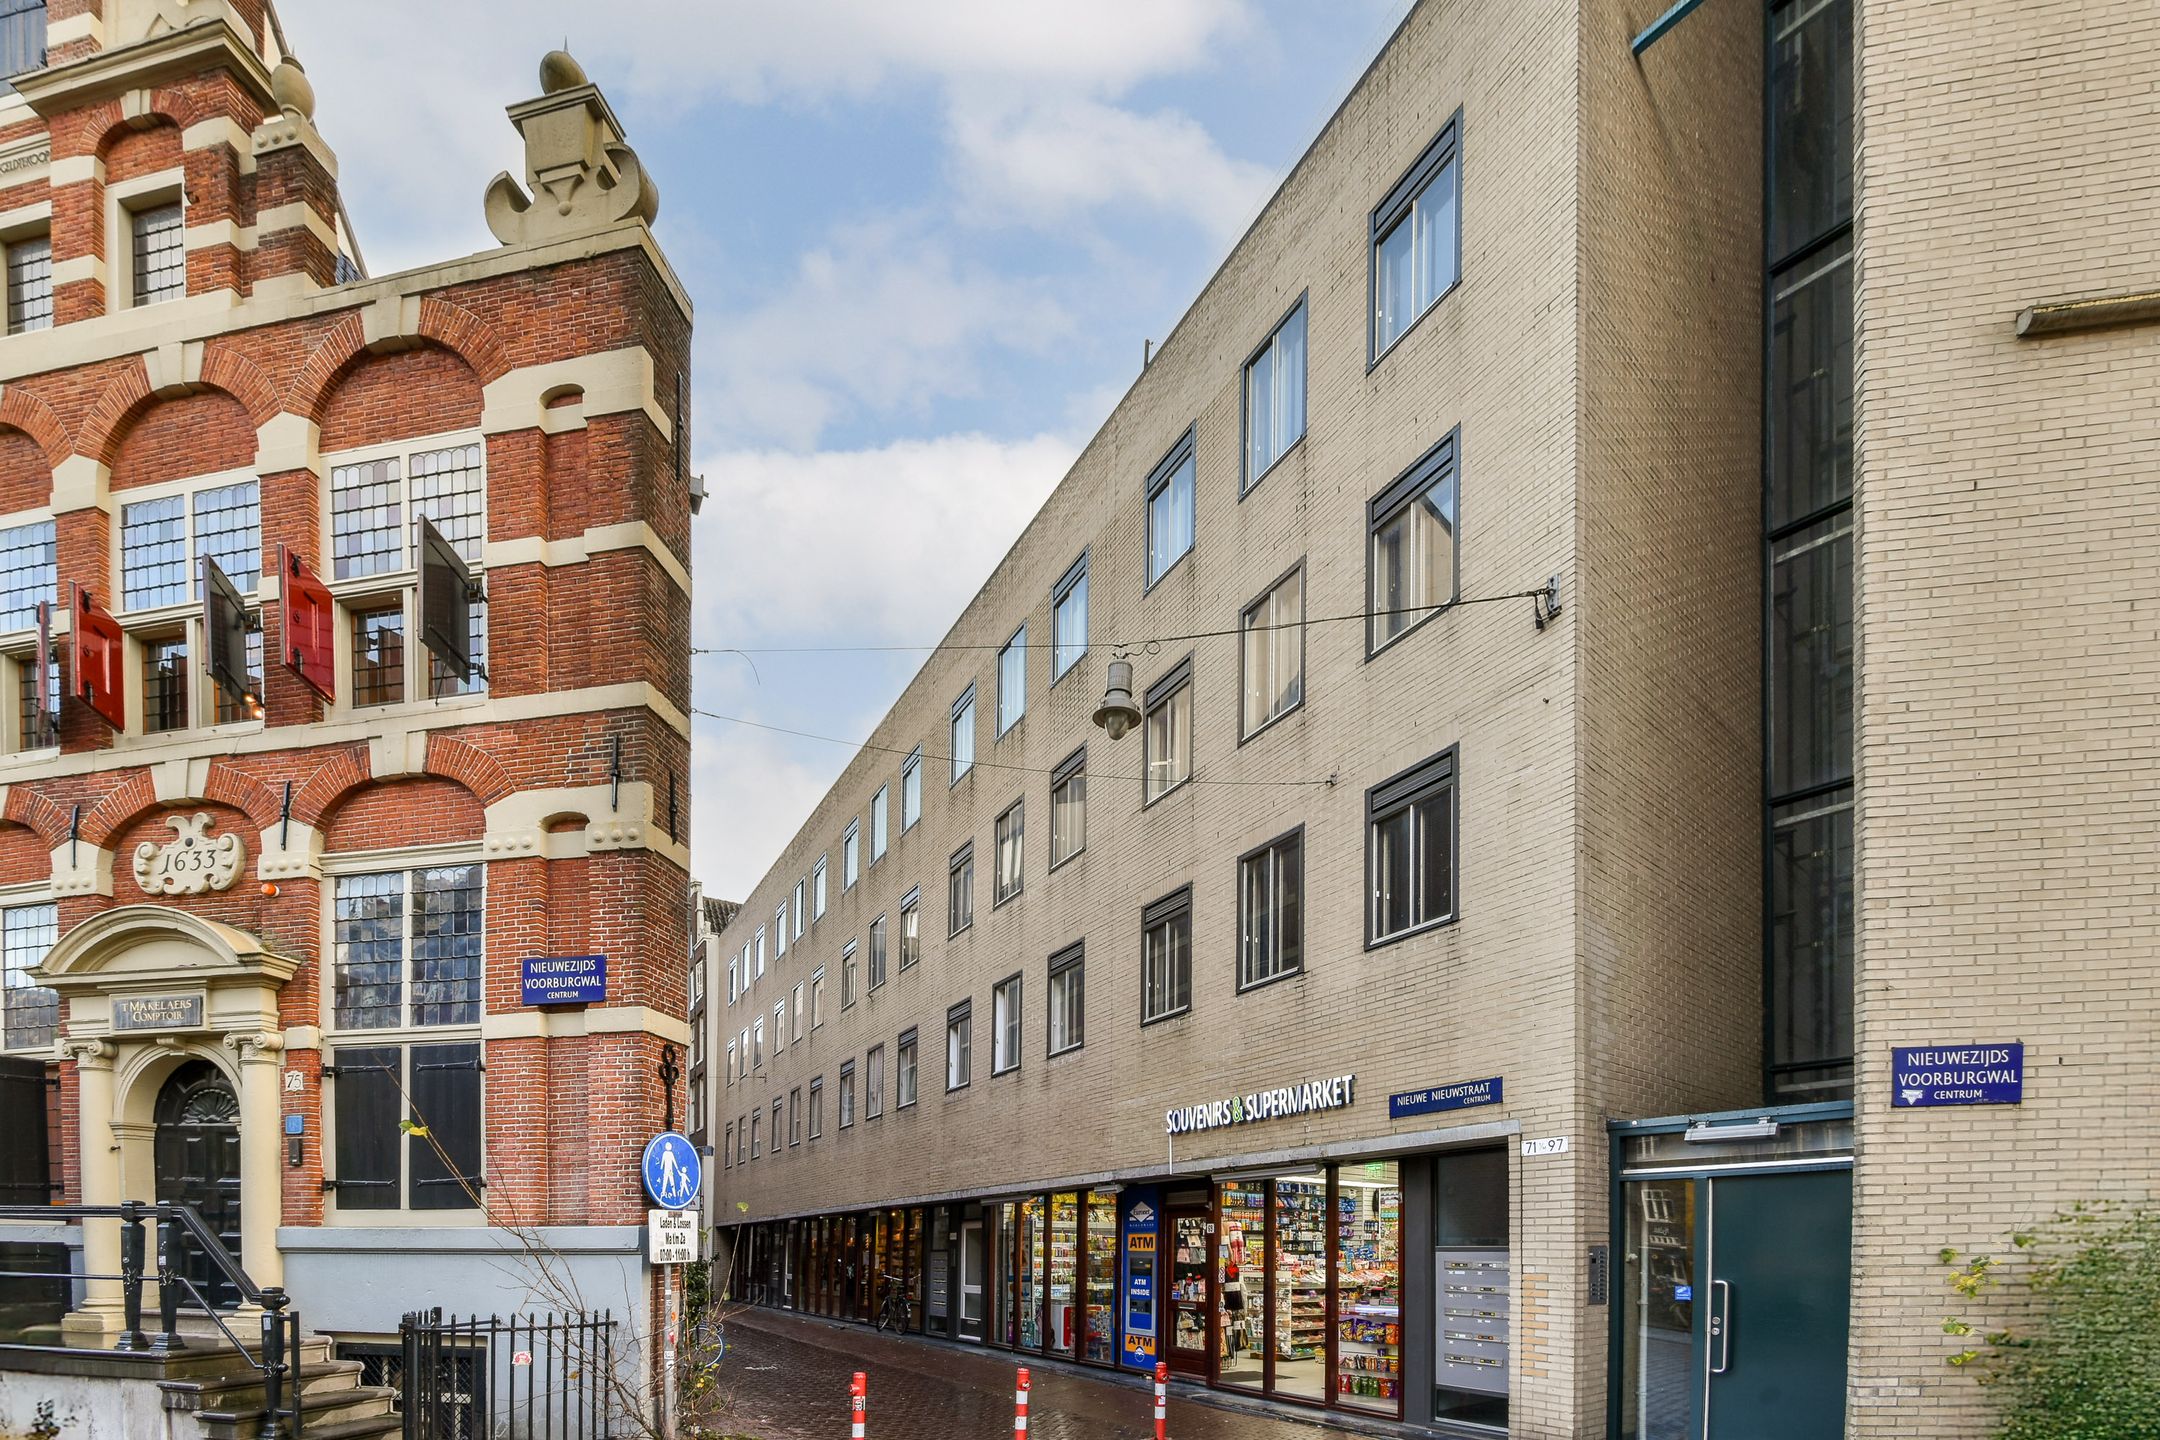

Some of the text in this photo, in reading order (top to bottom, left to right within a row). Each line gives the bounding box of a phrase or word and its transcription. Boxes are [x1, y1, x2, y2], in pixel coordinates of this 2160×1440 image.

[158, 849, 217, 875] 1633
[530, 960, 596, 974] NIEUWEZIJDS
[524, 975, 602, 989] VOORBURGWAL
[547, 991, 579, 999] CENTRUM
[1908, 1049, 2009, 1067] NIEUWEZIJDS
[287, 1074, 301, 1089] 75
[1899, 1069, 2018, 1087] VOORBURGWAL
[1397, 1082, 1491, 1106] NIEUWE NIEUWSTRAAT
[1463, 1094, 1491, 1105] CENTRUM
[1933, 1089, 1983, 1100] CENTRUM
[1166, 1074, 1355, 1134] SOUVENIRS & SUPERMARKET
[1525, 1141, 1537, 1154] 71
[1548, 1138, 1564, 1152] 97
[1129, 1236, 1154, 1249] ATM
[1134, 1278, 1147, 1286] ATM
[1130, 1288, 1150, 1296] INSIDE
[1128, 1335, 1152, 1347] ATM
